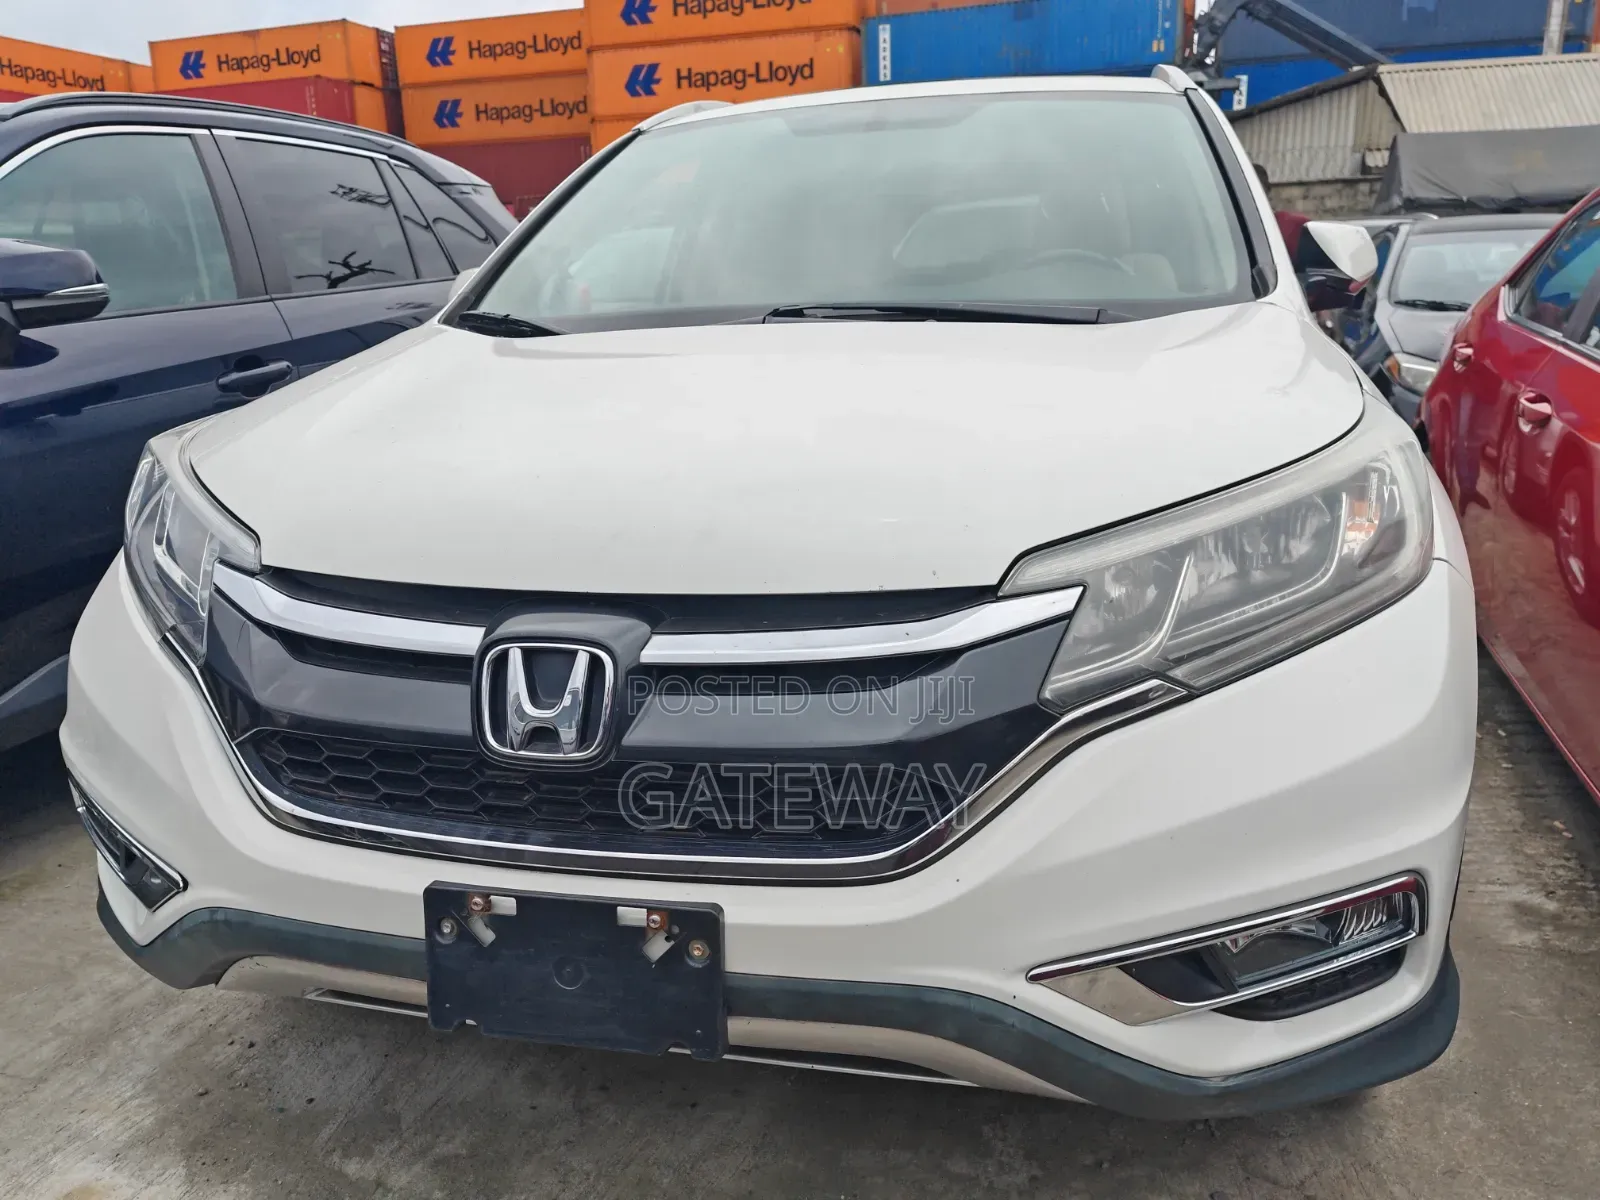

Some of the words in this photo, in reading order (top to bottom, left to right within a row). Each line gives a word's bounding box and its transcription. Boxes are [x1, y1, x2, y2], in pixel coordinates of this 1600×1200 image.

[672, 0, 812, 19] Hapag-Ly
[216, 44, 321, 74] Hapag-Lloyd
[467, 30, 582, 61] Hapag-Lloyd
[0, 56, 105, 92] Hapag-Lloyd
[675, 57, 815, 91] Hapag-Lloyd
[474, 95, 588, 125] Hapag-Lloyd
